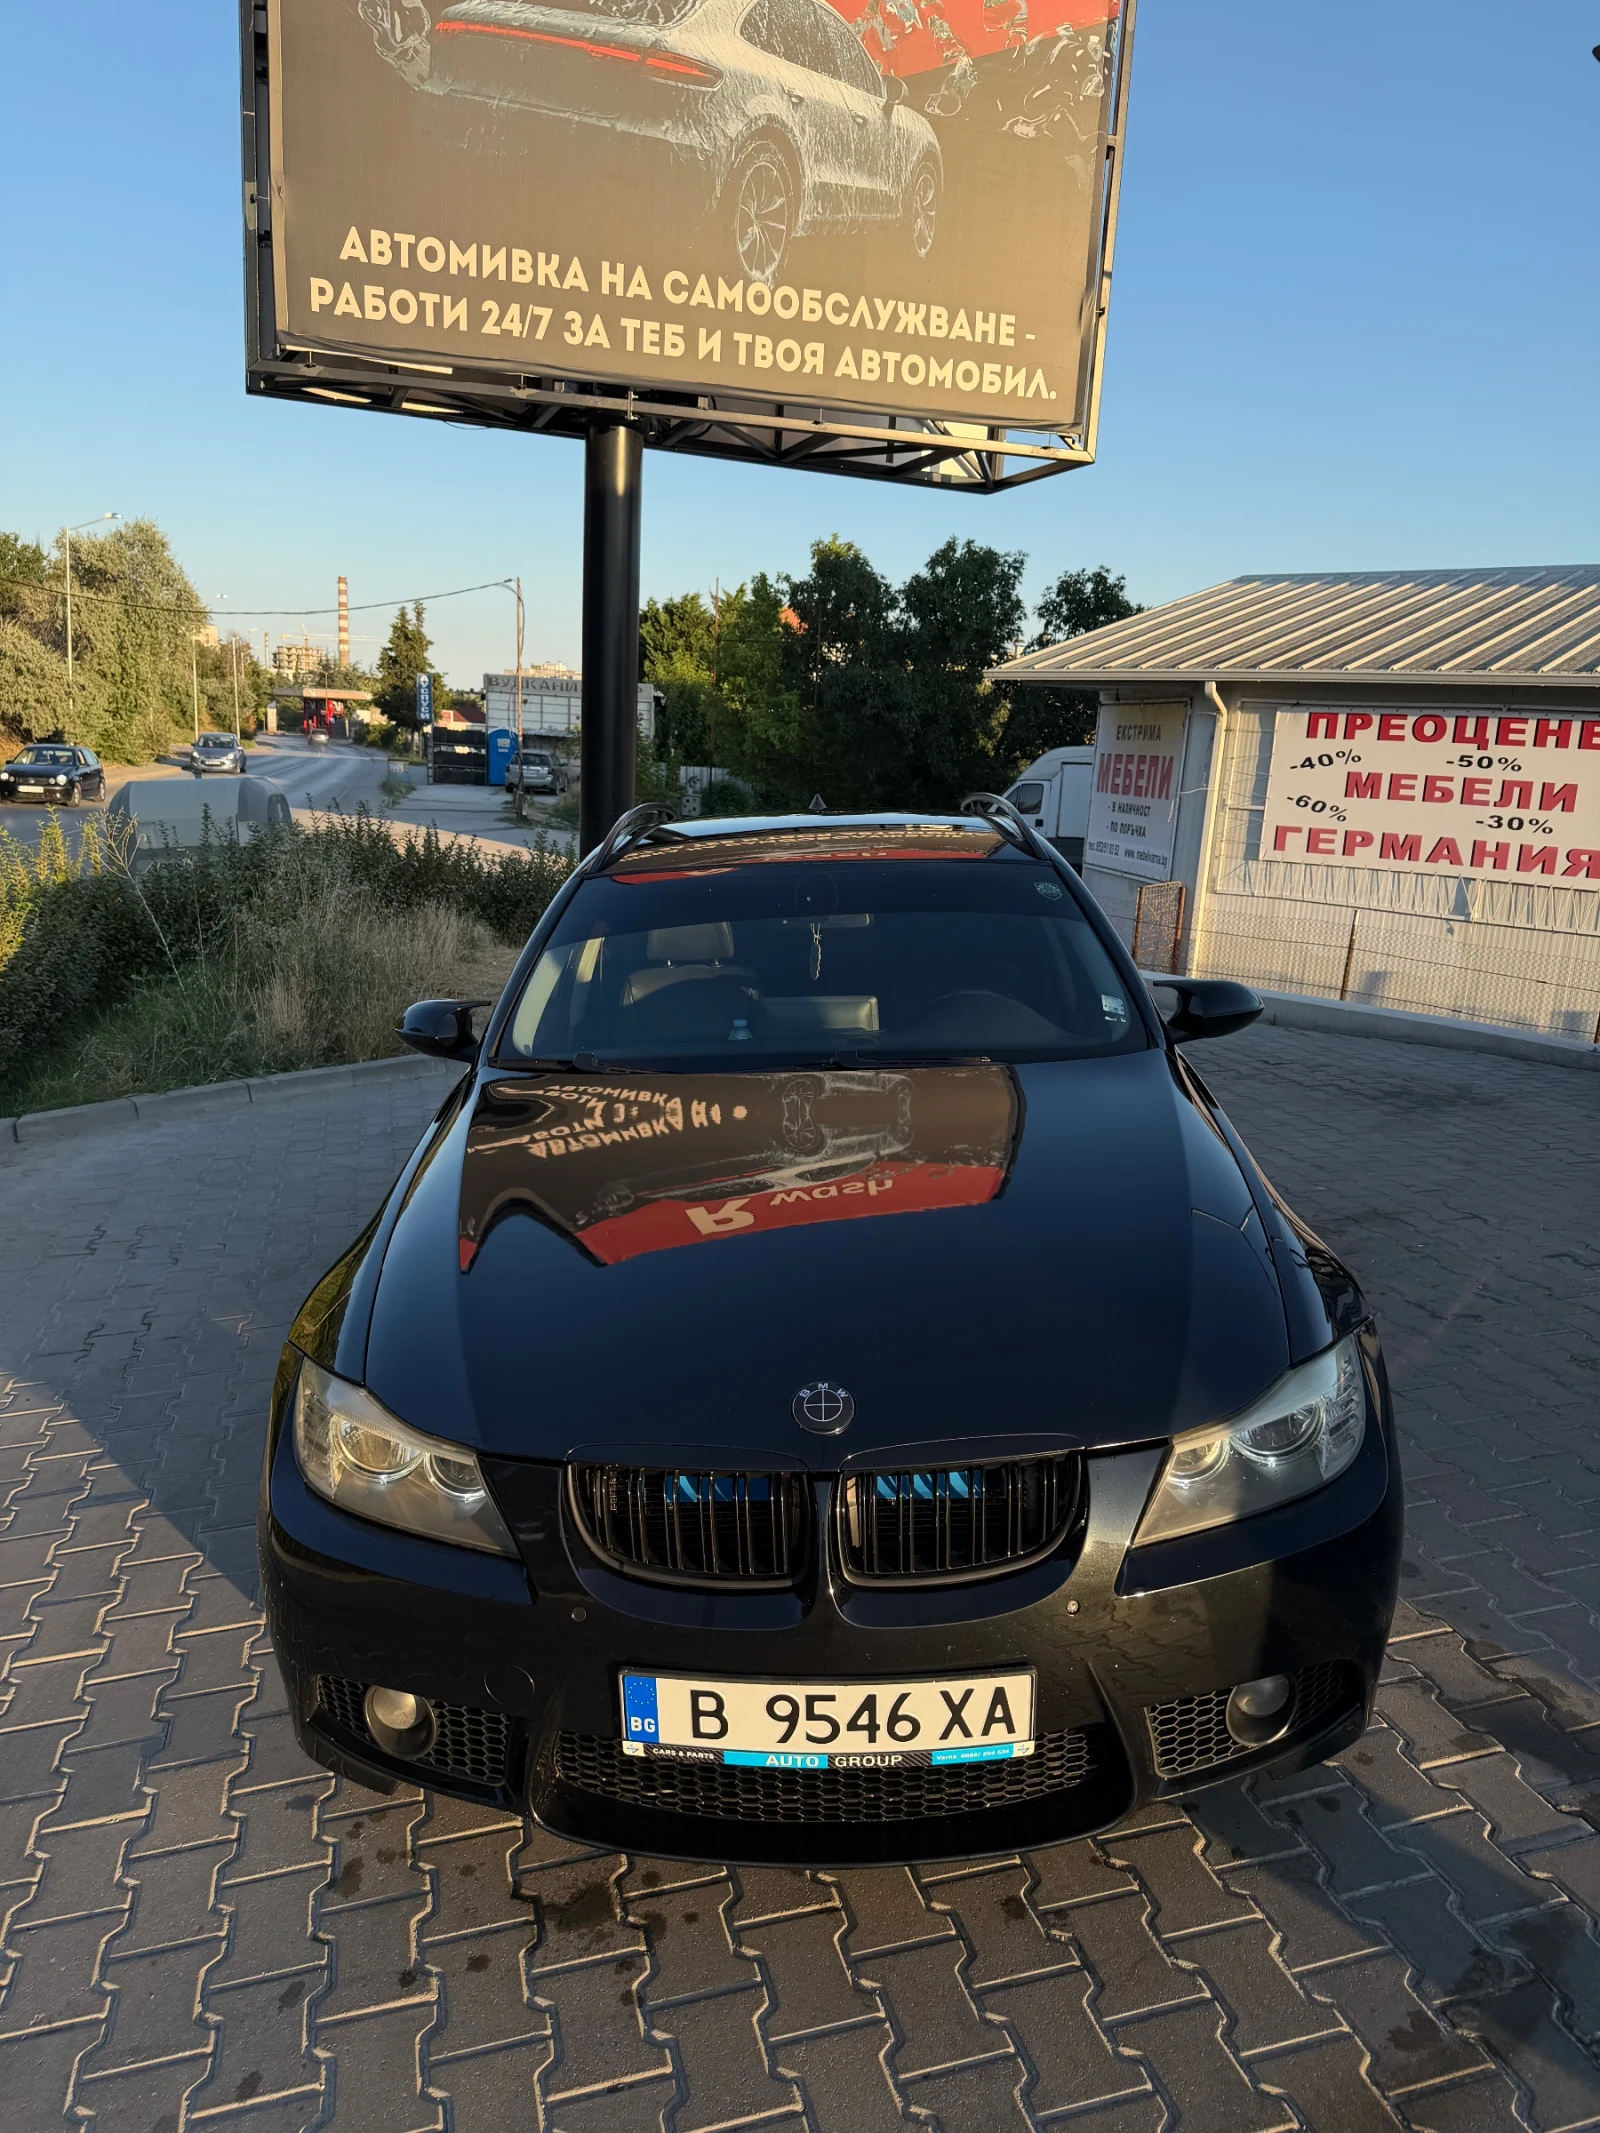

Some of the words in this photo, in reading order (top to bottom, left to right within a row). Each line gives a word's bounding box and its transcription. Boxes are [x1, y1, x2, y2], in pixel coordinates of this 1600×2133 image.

[340, 226, 589, 292] АВТОМИВКА
[602, 261, 652, 300] НА
[663, 271, 1015, 347] САМООБСЛУЖВАНЕ
[310, 277, 467, 331] РАБОТИ
[481, 300, 553, 340] 24/7
[564, 311, 611, 348] ЗА
[621, 318, 685, 357] ТЕБ
[698, 328, 721, 362] И
[733, 332, 824, 375] ТВОЯ
[834, 346, 1057, 399] АВТОМОБИЛ.
[420, 675, 430, 720] АУСПУСИ
[1116, 725, 1161, 741] ЕКСТРИМА
[1290, 749, 1361, 769] -40%
[1446, 755, 1522, 772] -50%
[1097, 754, 1174, 800] МЕБЕЛИ
[1344, 771, 1578, 813] МЕБЕЛИ
[1118, 802, 1151, 817] НАЛИЧНОСТ
[1287, 795, 1347, 822] -60%
[1110, 821, 1118, 833] ПО
[1120, 823, 1146, 838] ПОРЪЧКА
[1476, 815, 1553, 834] -30%
[1273, 825, 1600, 879] ГЕРМАНИЯ
[799, 1382, 849, 1398] BMW
[690, 1690, 729, 1740] B
[765, 1693, 921, 1744] 9546
[939, 1686, 1016, 1740] XA
[631, 1717, 655, 1733] BG
[653, 1748, 676, 1756] CARS
[765, 1755, 819, 1767] AUTO
[834, 1755, 902, 1767] GROUP
